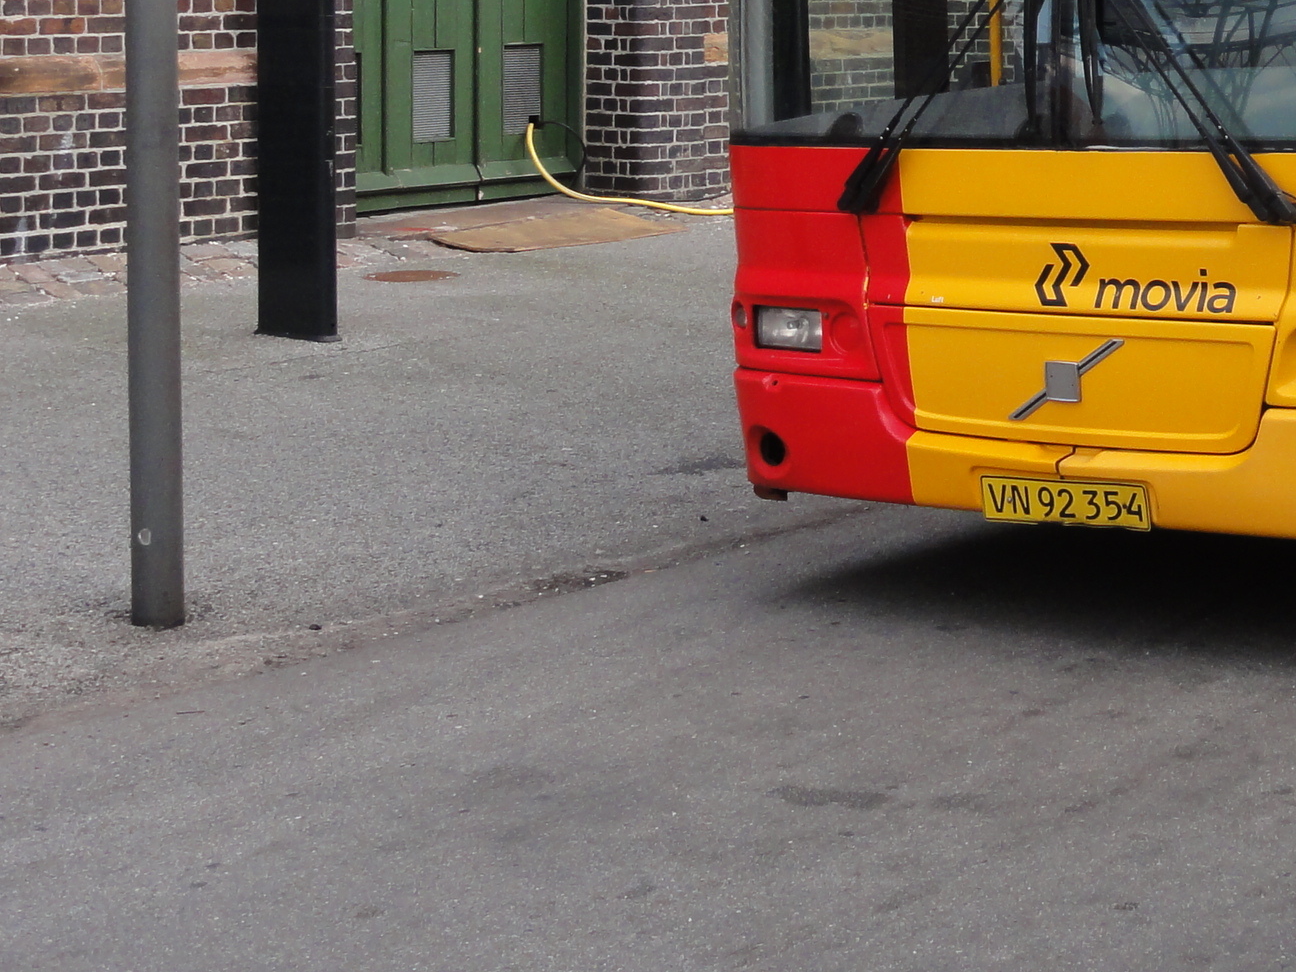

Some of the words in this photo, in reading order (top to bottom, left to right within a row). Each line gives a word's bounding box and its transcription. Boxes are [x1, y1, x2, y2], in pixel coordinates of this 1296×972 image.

[1094, 268, 1237, 313] movia
[988, 483, 1031, 515] VN
[1037, 486, 1076, 518] 92
[1082, 490, 1143, 522] 354
